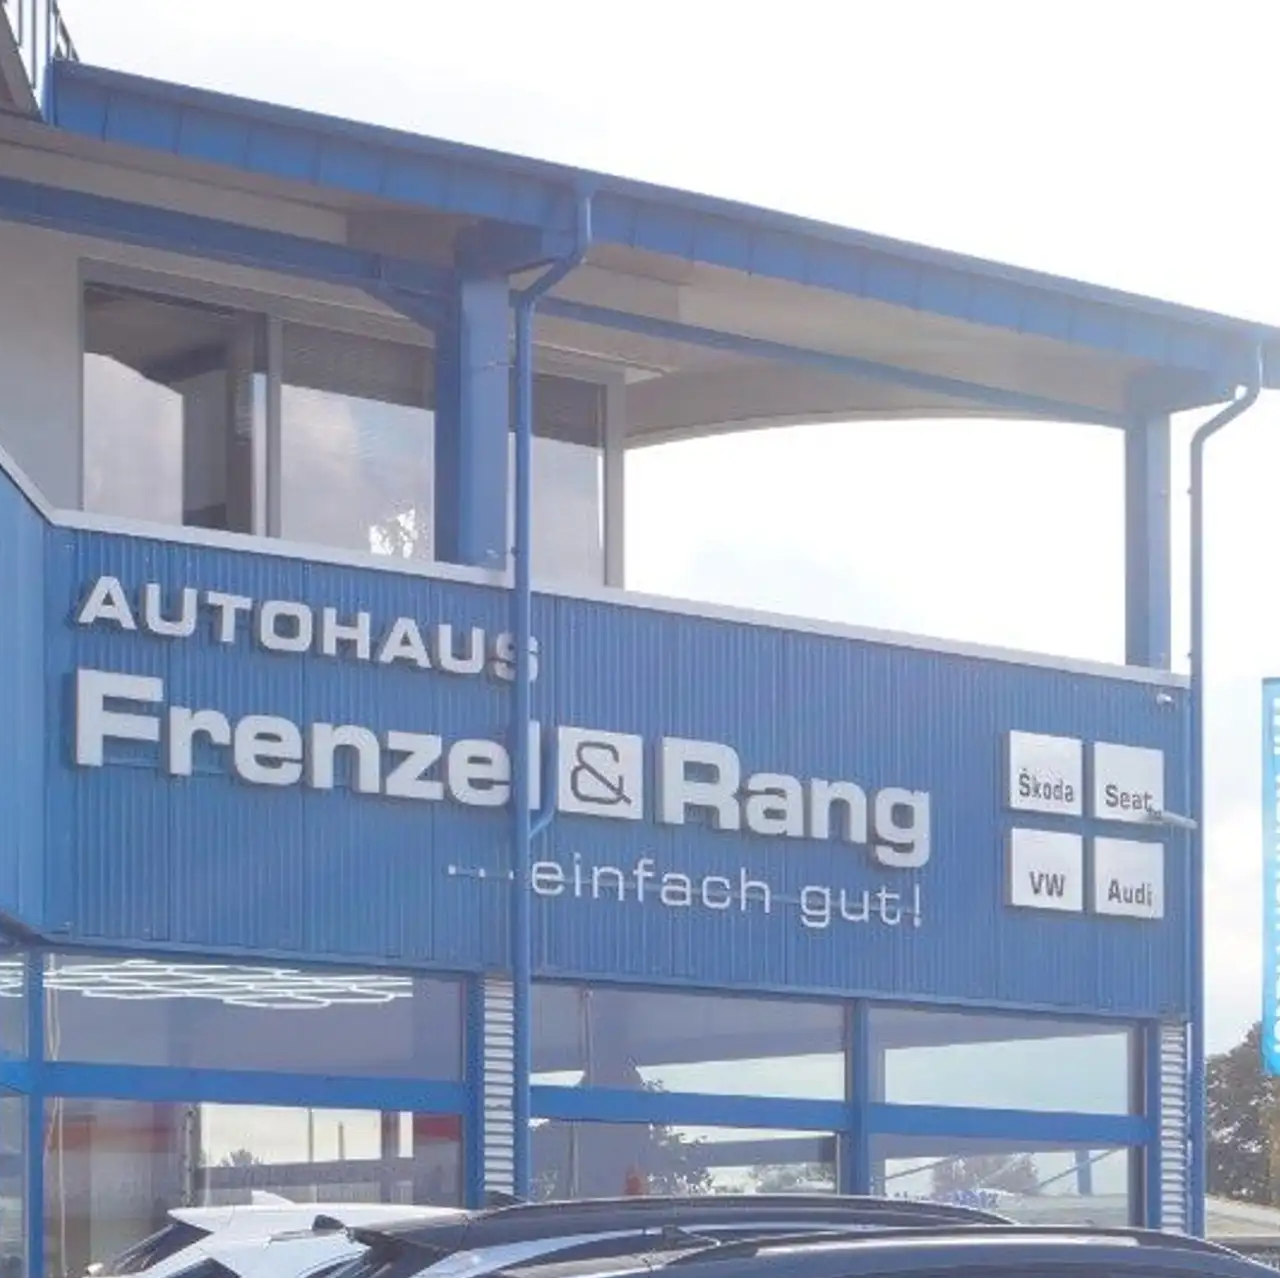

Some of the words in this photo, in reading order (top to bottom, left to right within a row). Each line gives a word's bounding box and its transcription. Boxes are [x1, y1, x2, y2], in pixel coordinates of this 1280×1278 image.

[78, 575, 540, 683] AUTOHAUS
[75, 668, 541, 810] Frenzel
[567, 737, 634, 809] &
[661, 736, 930, 868] Rang
[1104, 783, 1153, 812] Seat
[1029, 870, 1066, 897] VW
[1107, 878, 1153, 907] Audi
[800, 881, 924, 929] gut!
